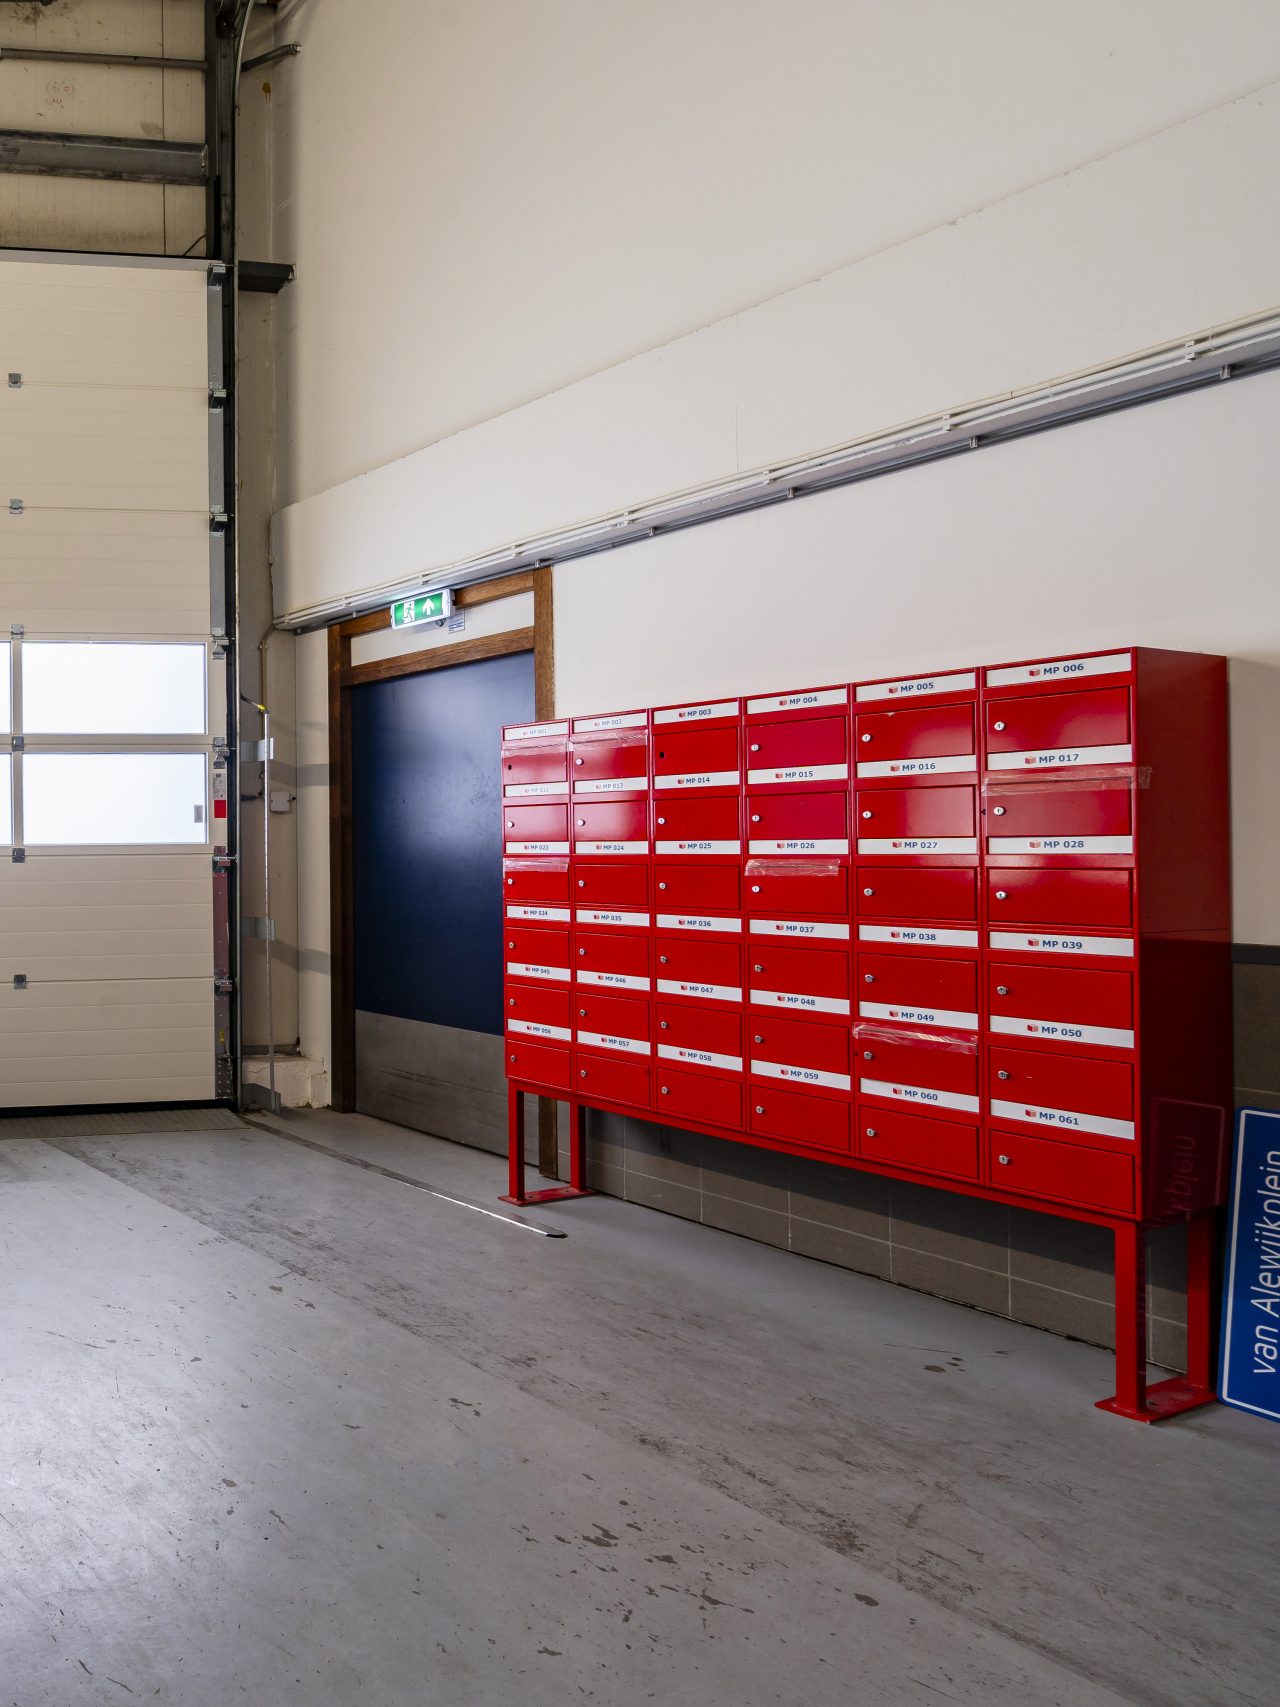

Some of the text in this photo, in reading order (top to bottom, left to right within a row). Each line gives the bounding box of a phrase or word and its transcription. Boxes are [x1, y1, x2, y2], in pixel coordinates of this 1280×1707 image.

[1043, 663, 1085, 676] MP 006
[900, 681, 934, 693] MP 005
[789, 695, 818, 705] MP 004
[699, 708, 712, 716] 003
[612, 718, 623, 726] 002
[1038, 753, 1080, 764] MP 017
[902, 762, 936, 772] MP 016
[784, 770, 814, 779] MP 015
[698, 776, 711, 784] 014
[699, 842, 712, 850] 025
[904, 841, 938, 849] MP 027
[1043, 840, 1085, 849] MP 028
[785, 924, 815, 934] MP 037
[902, 932, 937, 941] MP 038
[1042, 939, 1083, 950] MP 039
[615, 976, 627, 984] 046
[701, 986, 714, 994] 047
[786, 996, 816, 1006] MP 048
[900, 1011, 935, 1022] MP 049
[542, 1027, 552, 1035] 056
[1041, 1025, 1083, 1038] MP 050
[687, 1051, 713, 1062] MP 058
[790, 1069, 819, 1080] MP 059
[904, 1089, 938, 1101] MP 060
[1039, 1111, 1080, 1126] MP 061
[1253, 1324, 1279, 1373] van
